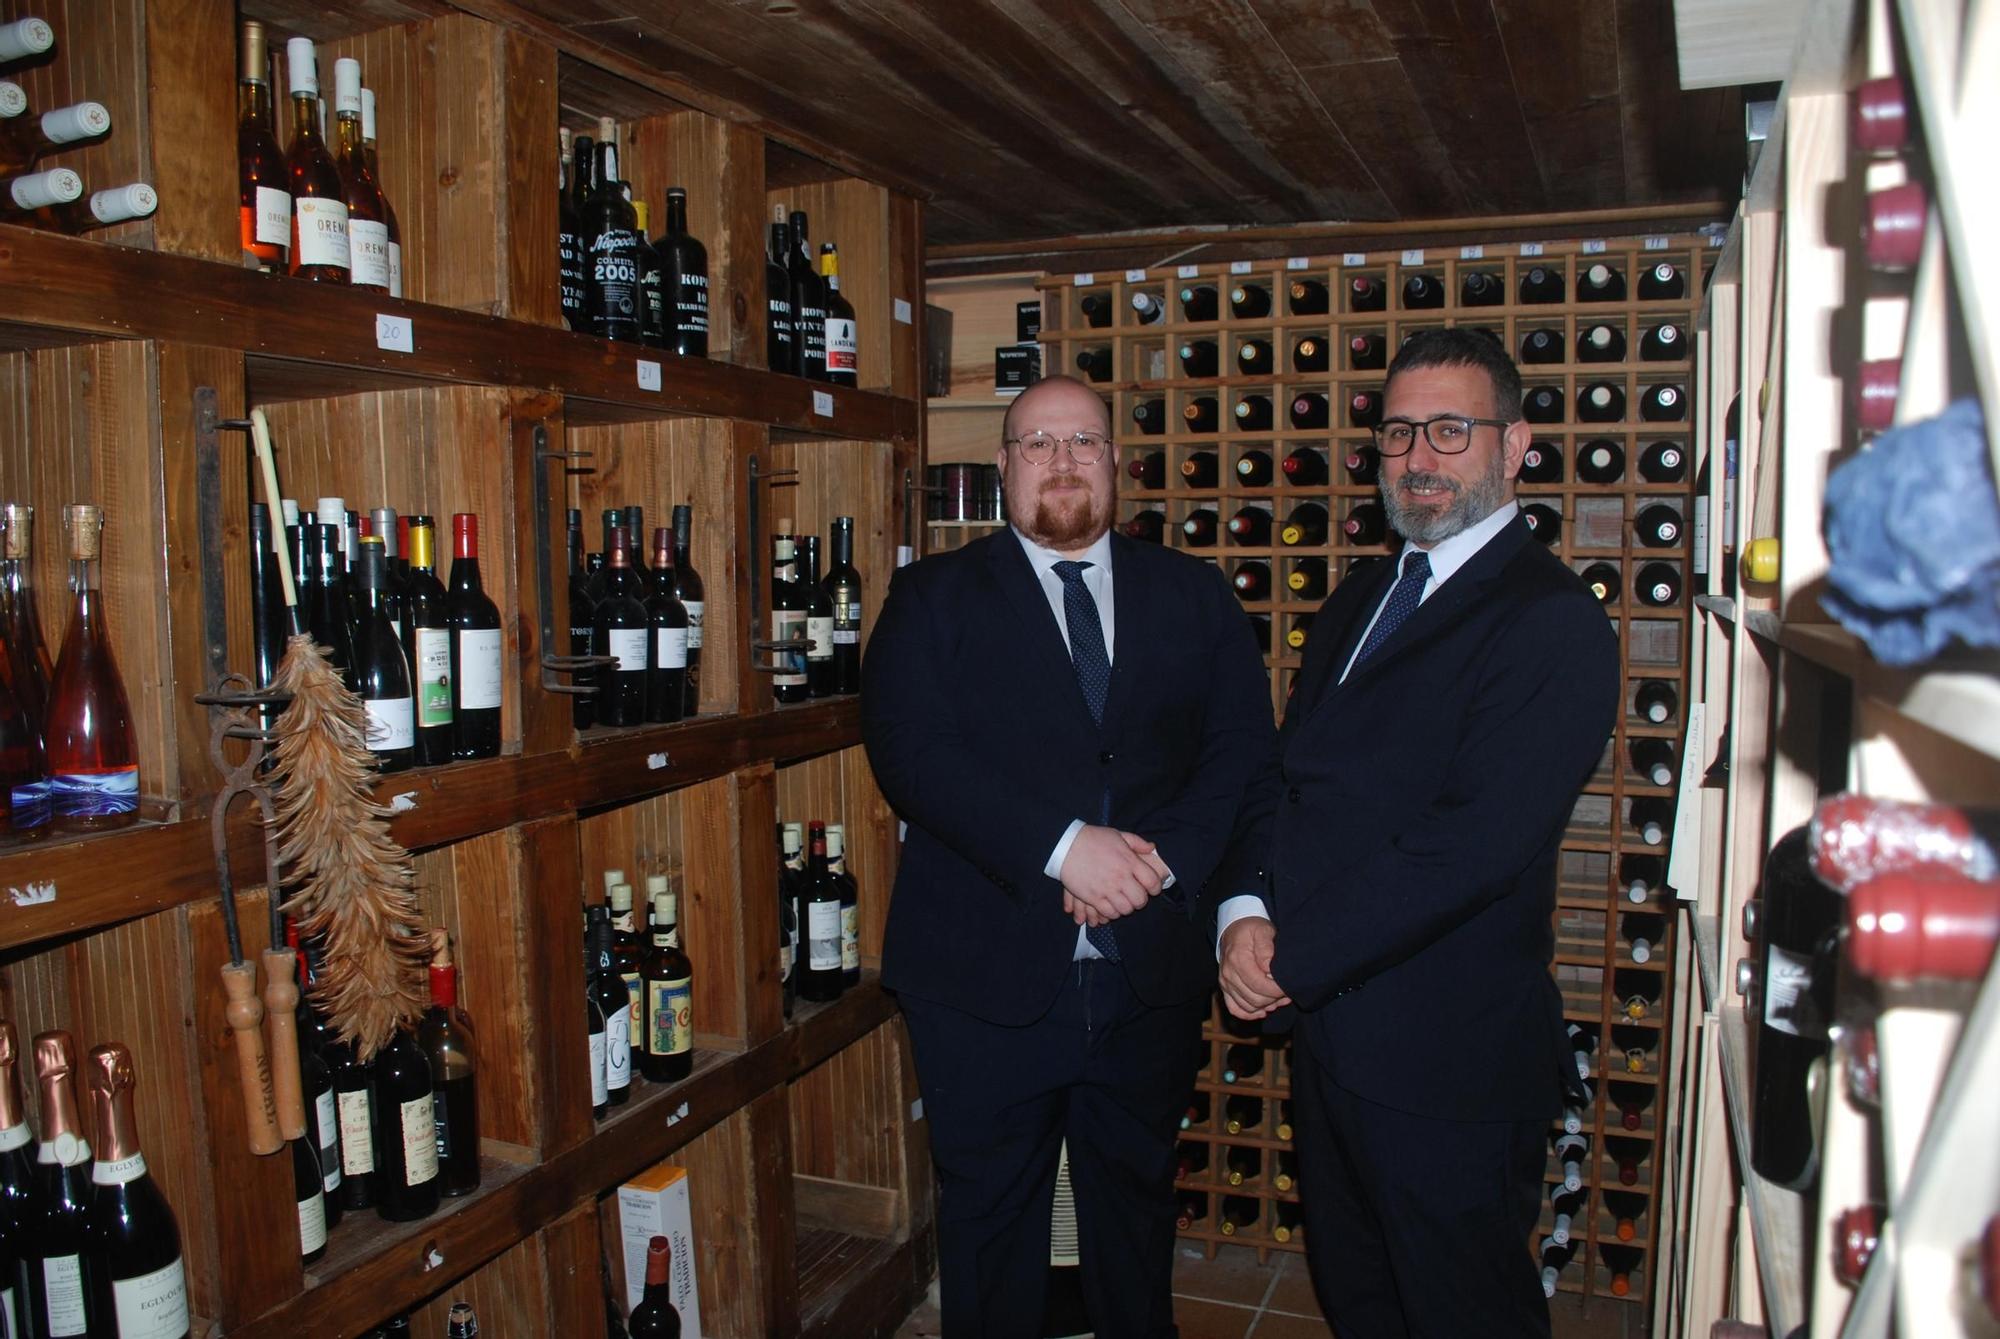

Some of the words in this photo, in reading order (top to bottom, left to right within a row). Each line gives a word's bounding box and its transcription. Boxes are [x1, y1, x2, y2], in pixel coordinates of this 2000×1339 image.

[267, 212, 289, 226] OREM
[594, 264, 636, 282] 2005
[697, 291, 707, 304] 10
[382, 321, 401, 340] 20
